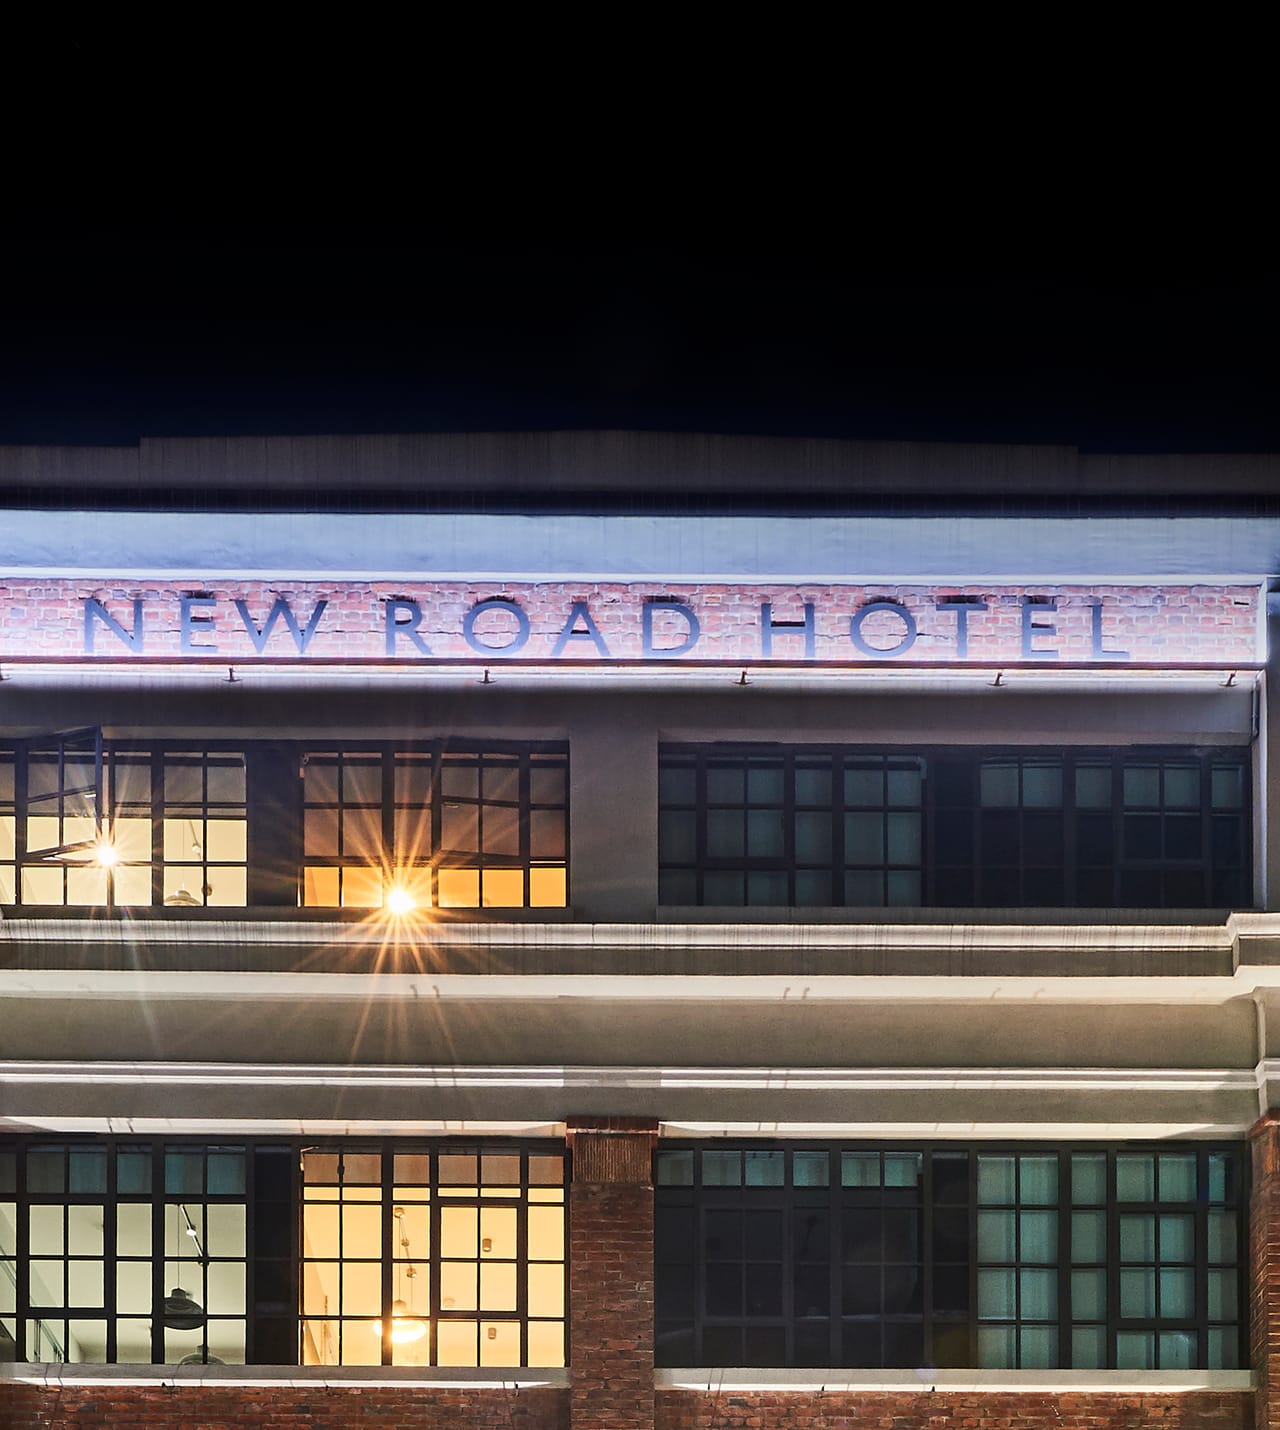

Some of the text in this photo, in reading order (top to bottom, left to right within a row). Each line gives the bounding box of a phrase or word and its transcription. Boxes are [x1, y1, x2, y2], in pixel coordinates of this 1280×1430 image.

[83, 597, 1130, 659] NEW ROAD HOTEL
